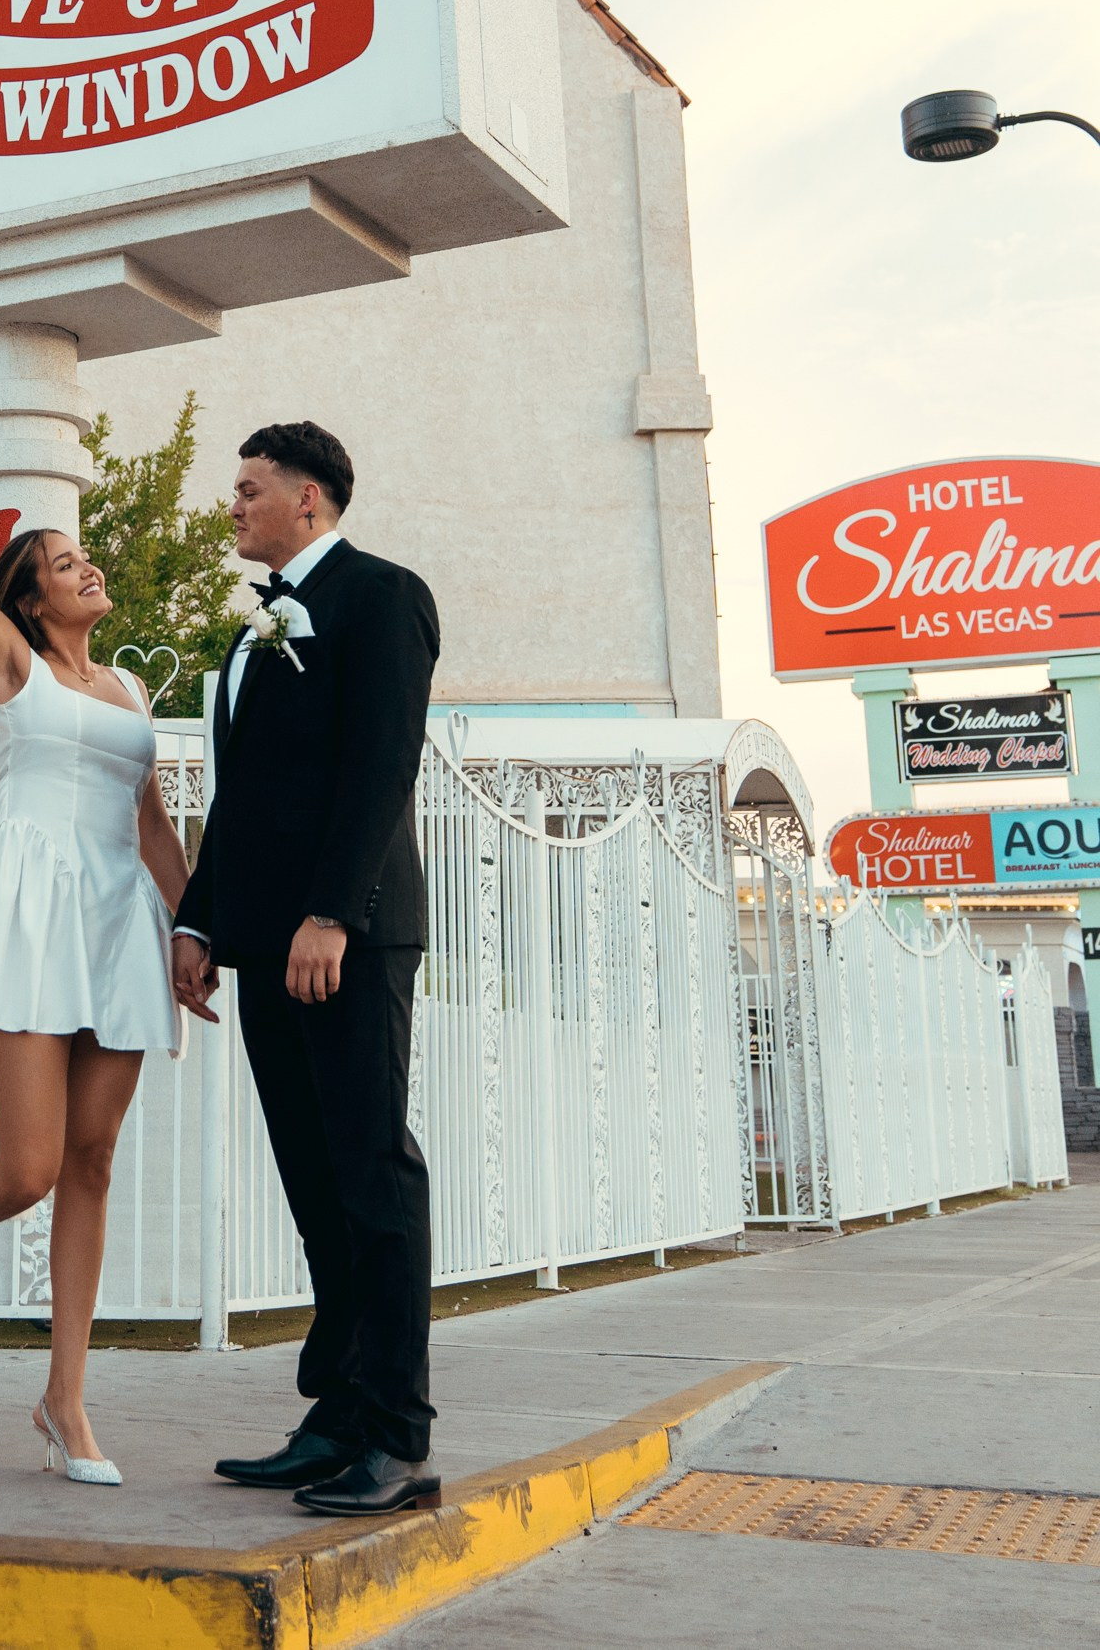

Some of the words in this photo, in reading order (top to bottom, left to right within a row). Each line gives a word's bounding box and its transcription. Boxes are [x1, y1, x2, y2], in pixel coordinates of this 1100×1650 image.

[0, 3, 315, 141] WINDOW
[908, 476, 1023, 512] HOTEL
[796, 508, 1100, 615] Shalima
[901, 611, 949, 639] LAS
[957, 605, 1053, 634] VEGAS
[927, 703, 1041, 734] Shalimar
[908, 742, 991, 772] Wedding
[996, 736, 1064, 769] Chapel
[855, 821, 974, 857] Shalimar
[858, 852, 976, 882] HOTEL
[1005, 863, 1060, 872] BREAKFAST
